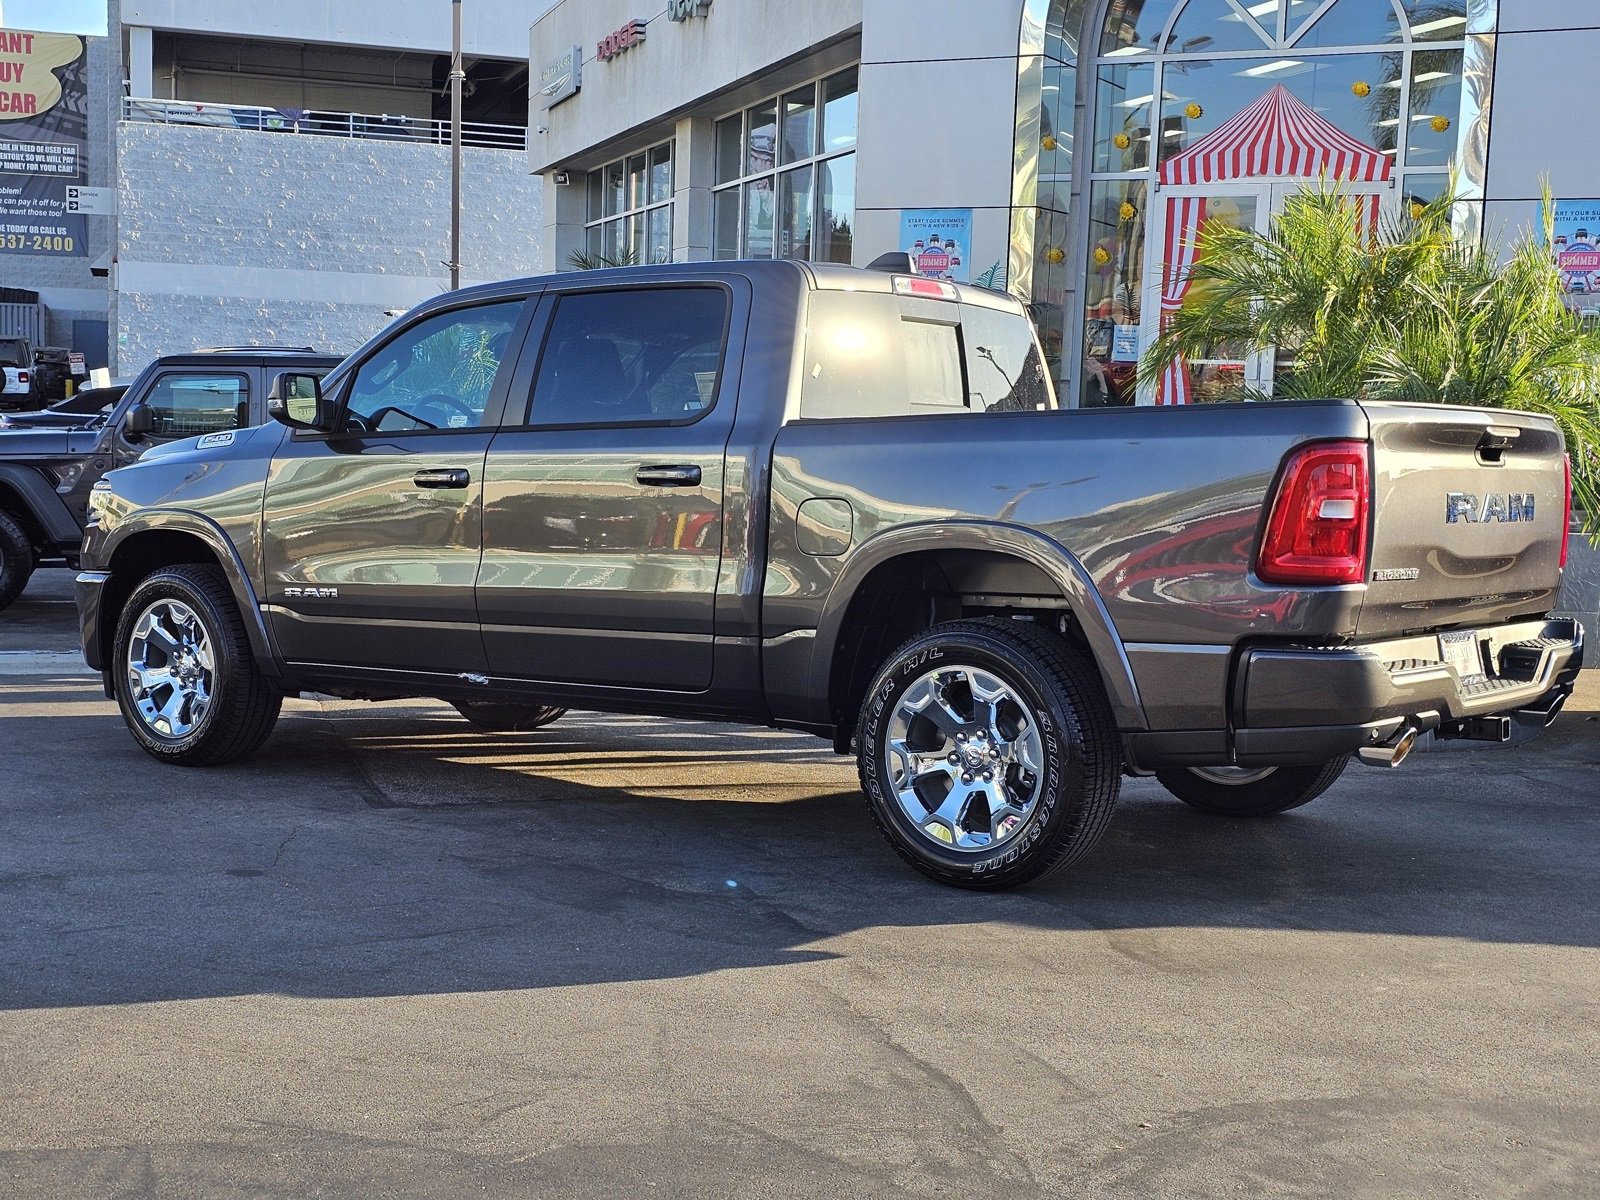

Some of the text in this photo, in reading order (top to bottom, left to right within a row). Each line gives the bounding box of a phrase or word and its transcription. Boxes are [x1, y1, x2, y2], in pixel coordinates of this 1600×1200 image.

[596, 18, 647, 62] DODGE
[0, 92, 36, 114] CAR
[20, 144, 35, 153] NEED
[45, 146, 61, 154] USED
[62, 147, 75, 155] CAR
[46, 155, 61, 163] WILL
[62, 156, 73, 164] PAY
[4, 161, 25, 170] MONEY
[27, 163, 38, 171] FOR
[40, 164, 56, 172] YOUR
[58, 165, 73, 173] CAR!
[18, 199, 32, 207] pay
[50, 199, 60, 207] for
[28, 208, 47, 216] those
[6, 224, 28, 233] TODAY
[29, 226, 39, 234] OR
[40, 226, 56, 234] CALL
[57, 227, 67, 235] US
[0, 234, 73, 252] 537-2400
[920, 257, 947, 266] SUMMER
[1561, 256, 1598, 266] SUMMER
[1445, 492, 1535, 524] RAM
[284, 587, 338, 598] RAM
[865, 648, 944, 801] DUELER H/L
[972, 708, 1060, 874] BRIDGESTONE
